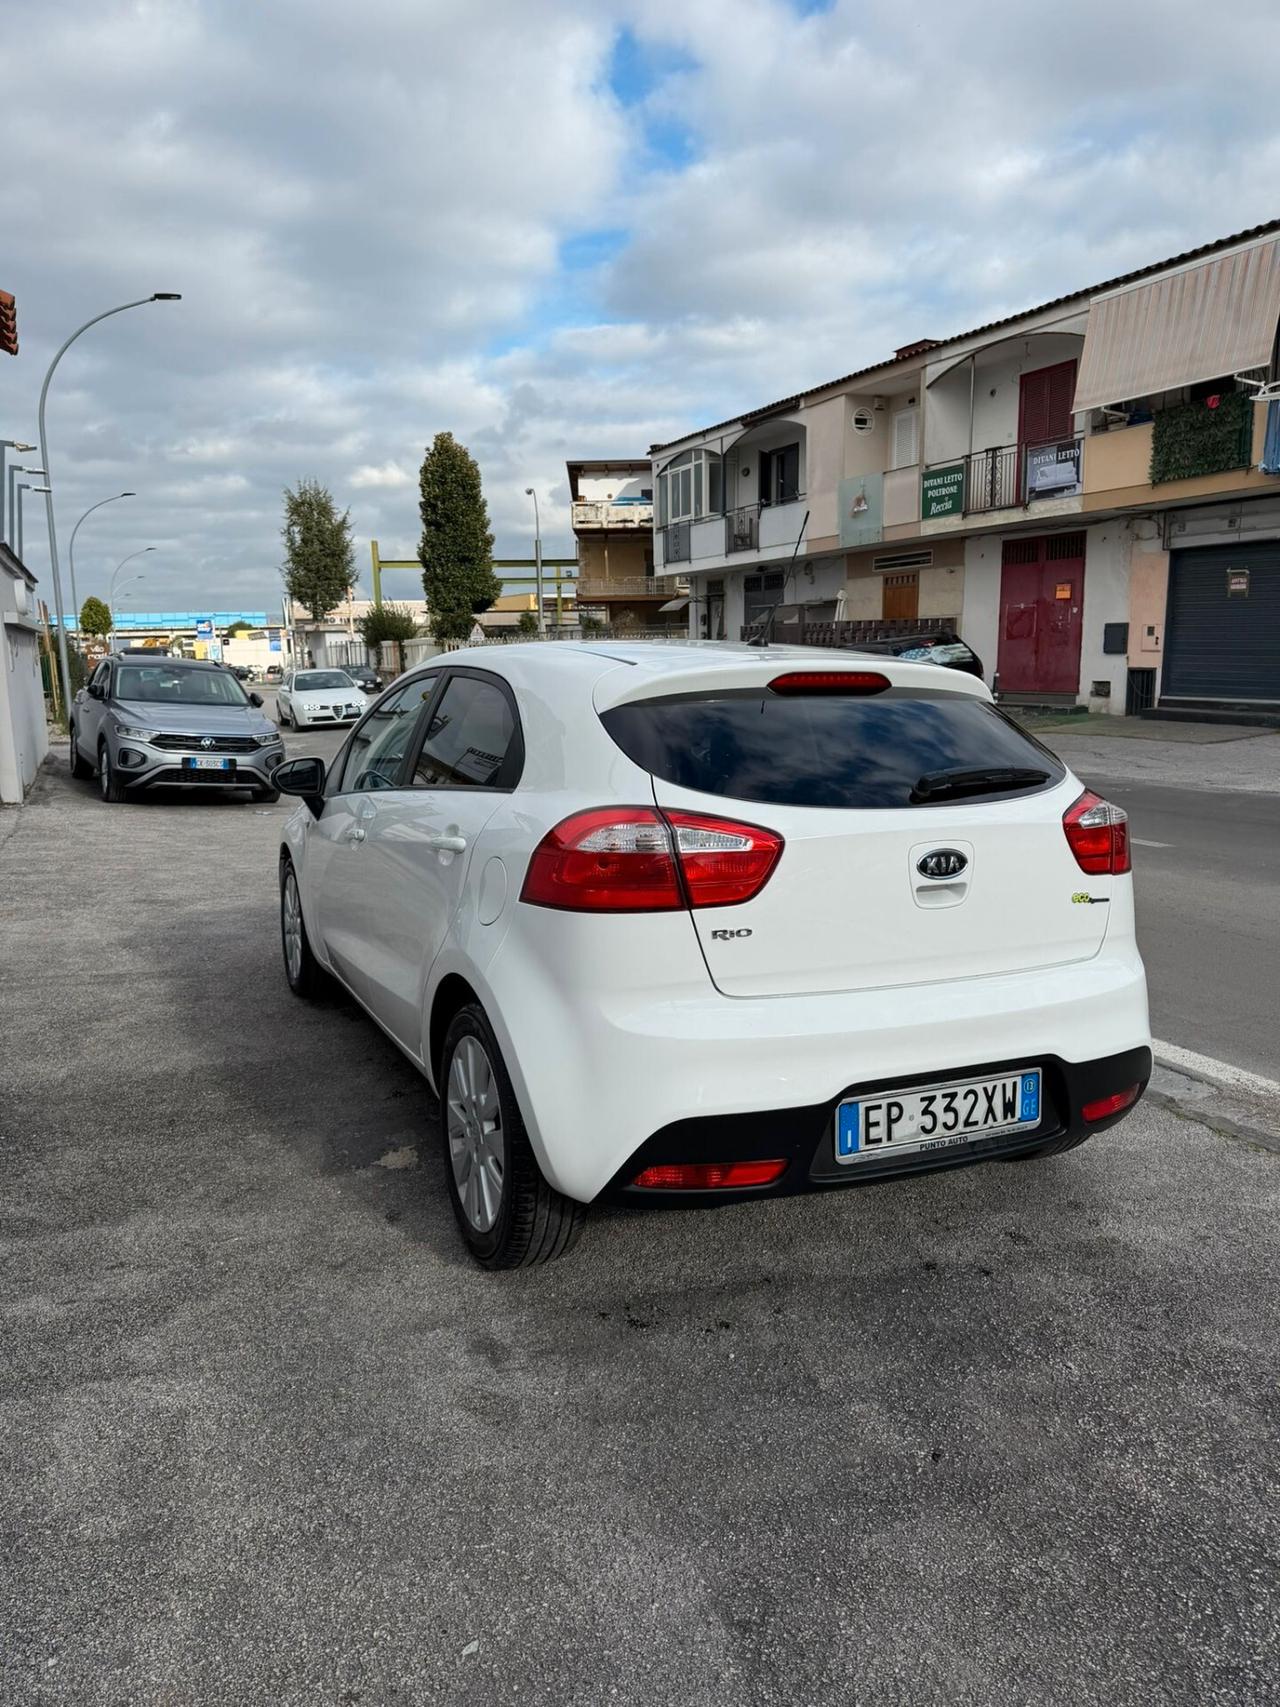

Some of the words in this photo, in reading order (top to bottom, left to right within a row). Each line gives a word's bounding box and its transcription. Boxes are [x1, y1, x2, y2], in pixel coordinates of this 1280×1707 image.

[1033, 453, 1057, 465] DIVANI
[1058, 448, 1080, 461] LETTO
[923, 477, 944, 489] DIVANI
[944, 473, 963, 484] LETTO
[927, 485, 958, 498] POLTRONE
[926, 855, 961, 873] KIA
[864, 1101, 904, 1146] EP
[919, 1080, 1018, 1135] 332XW
[1022, 1098, 1037, 1116] GE
[919, 1140, 946, 1151] PUNTO
[948, 1135, 969, 1146] AUTO
